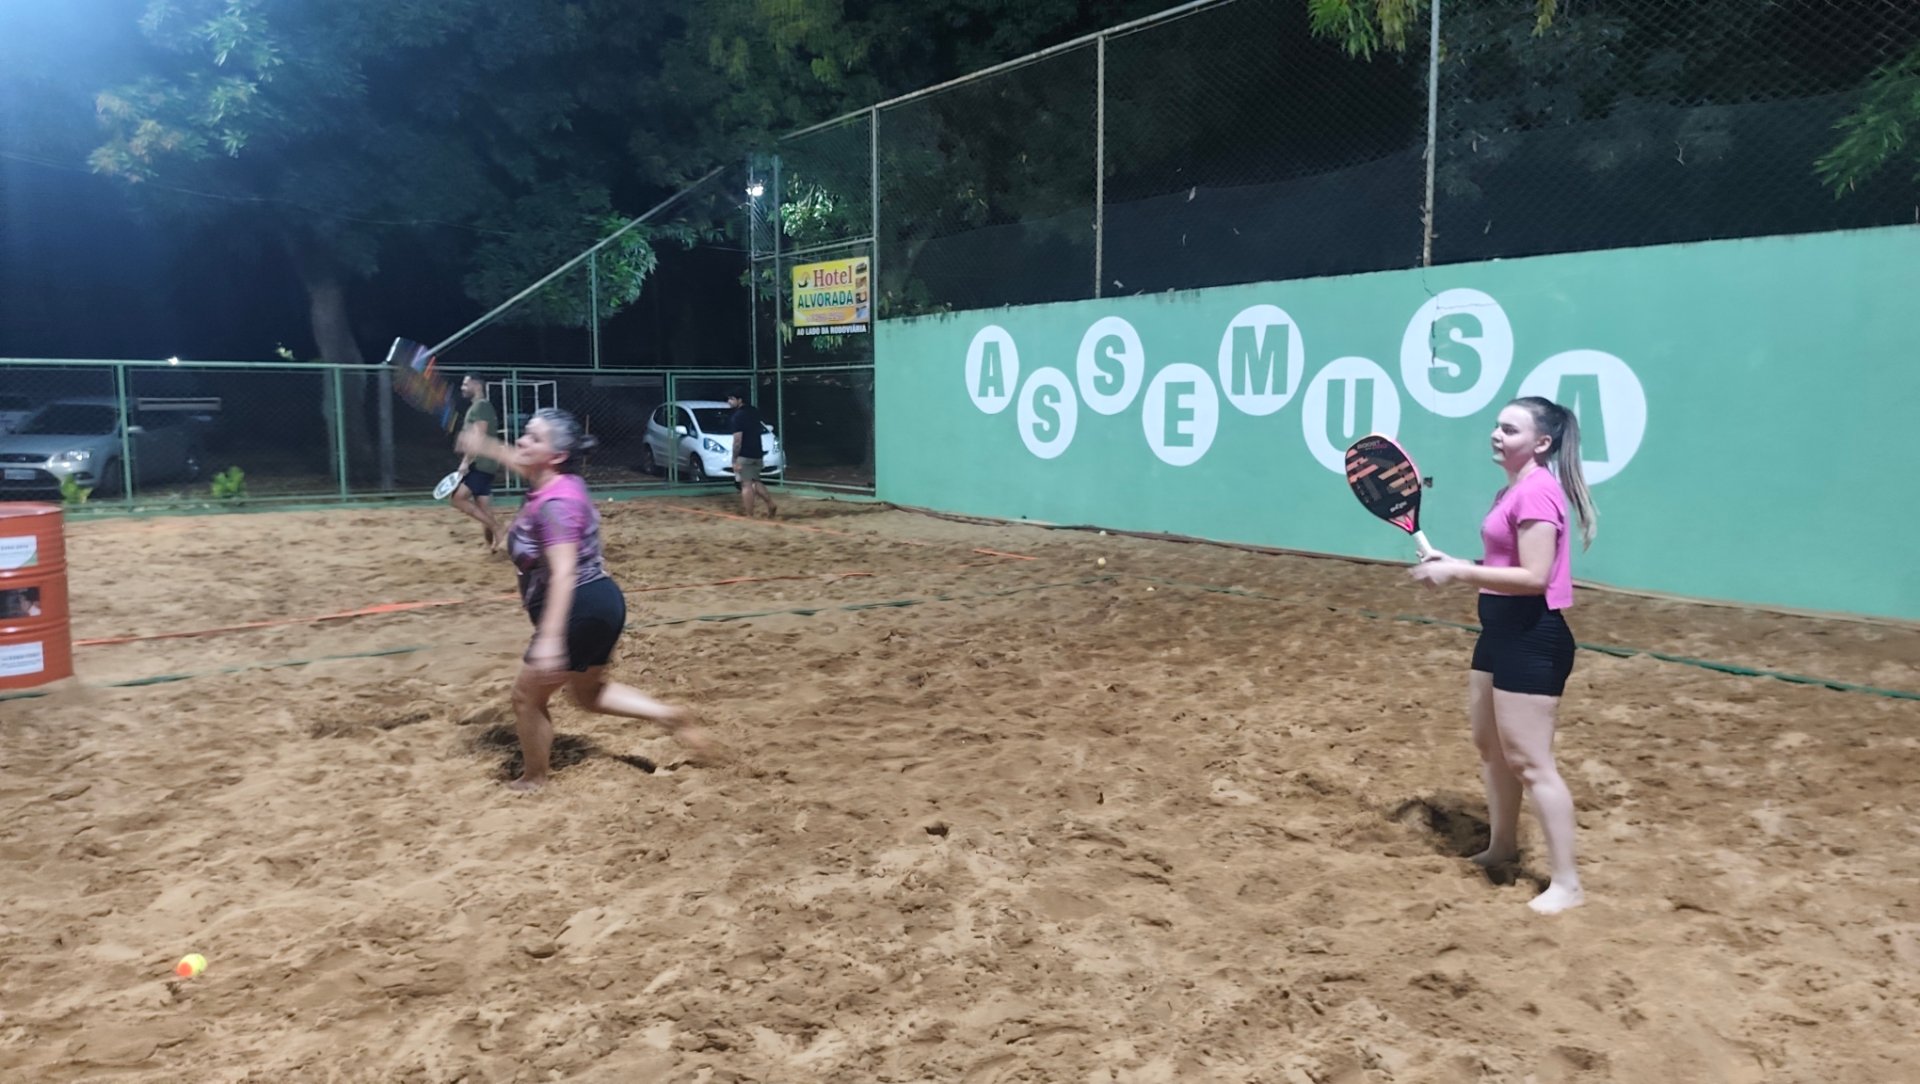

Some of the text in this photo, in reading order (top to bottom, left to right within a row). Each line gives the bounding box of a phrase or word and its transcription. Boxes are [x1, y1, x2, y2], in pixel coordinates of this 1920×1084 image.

[813, 265, 853, 287] Hotel
[798, 290, 853, 308] ALVORADA
[796, 328, 804, 336] AO
[805, 327, 820, 335] LADO
[821, 326, 829, 334] DA
